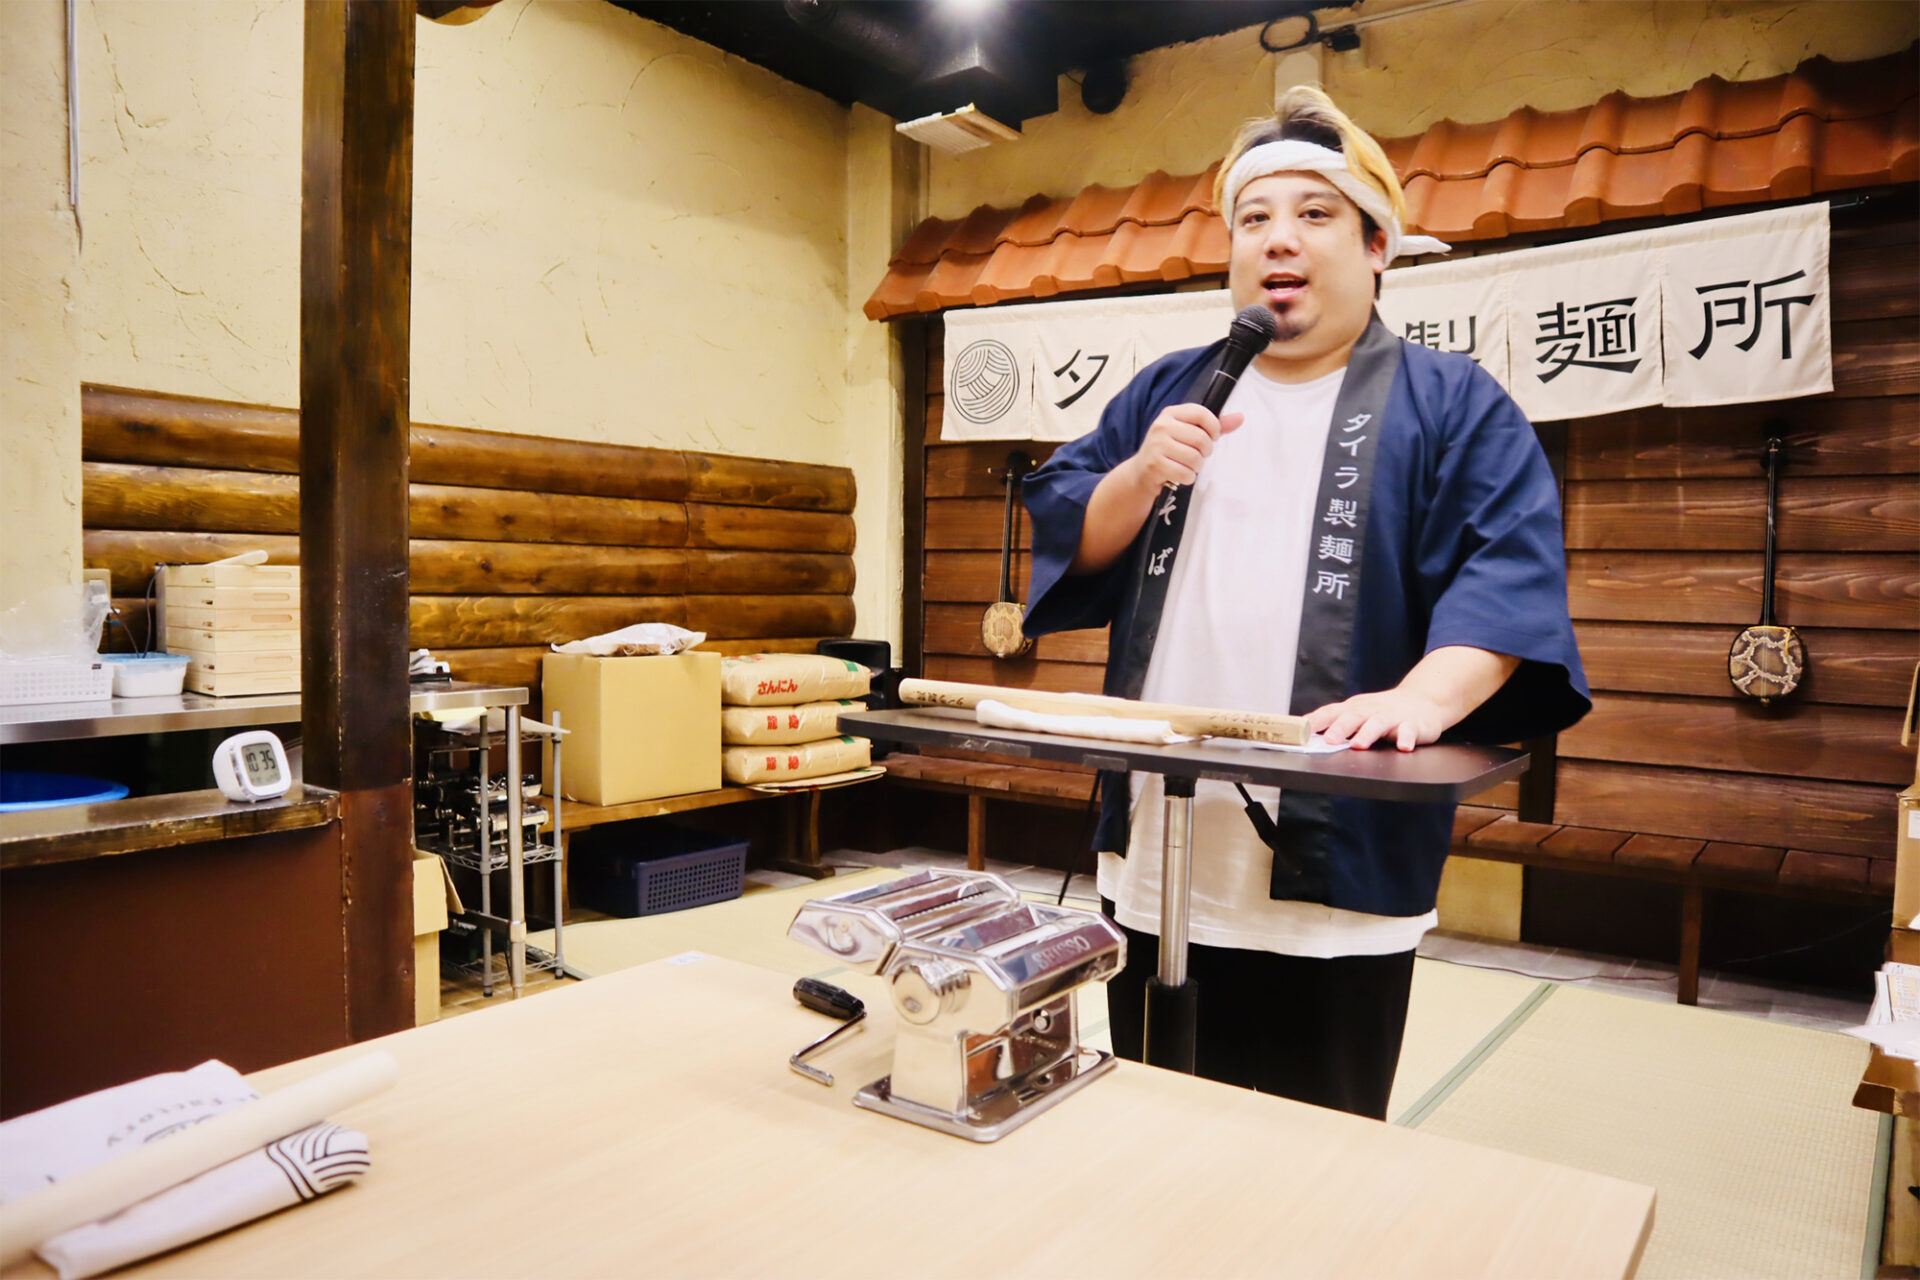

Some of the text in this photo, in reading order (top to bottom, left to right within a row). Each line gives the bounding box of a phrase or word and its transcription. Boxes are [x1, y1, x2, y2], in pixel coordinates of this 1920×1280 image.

[1312, 412, 1373, 601] タイラ製麺所
[756, 678, 799, 696] さんにん
